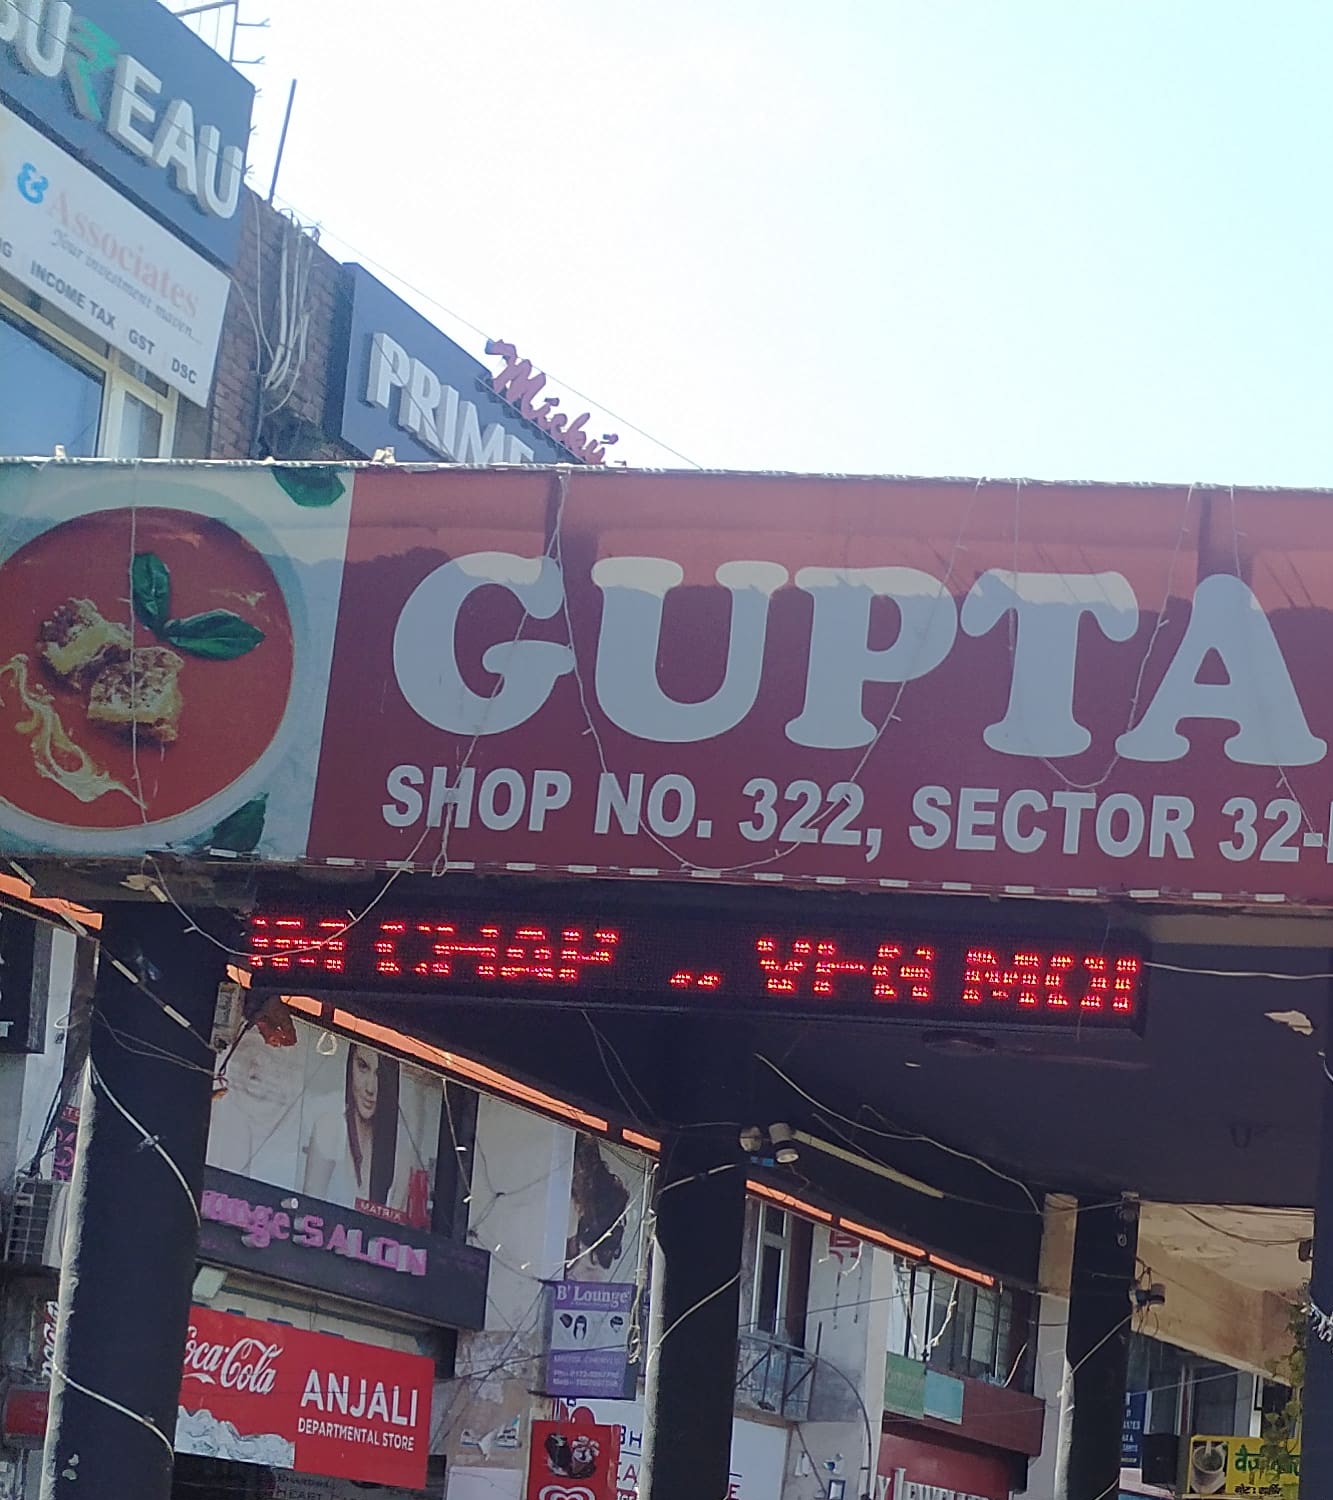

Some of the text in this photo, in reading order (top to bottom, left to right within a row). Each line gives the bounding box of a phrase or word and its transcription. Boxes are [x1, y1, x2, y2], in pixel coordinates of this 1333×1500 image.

[17, 162, 49, 204] &
[47, 191, 199, 318] Associates
[30, 260, 198, 385] INCOME TAX GST DSC
[393, 551, 1327, 766] GUPTA
[382, 764, 572, 833] SHOP
[596, 773, 711, 839] NO.
[740, 777, 882, 862] 322,
[910, 786, 1193, 856] SECTOR
[359, 1201, 402, 1220] MATRIX
[574, 1285, 630, 1308] Lounge
[298, 1417, 415, 1451] DEPARTMENTAL STORE
[300, 1369, 418, 1427] ANJALI
